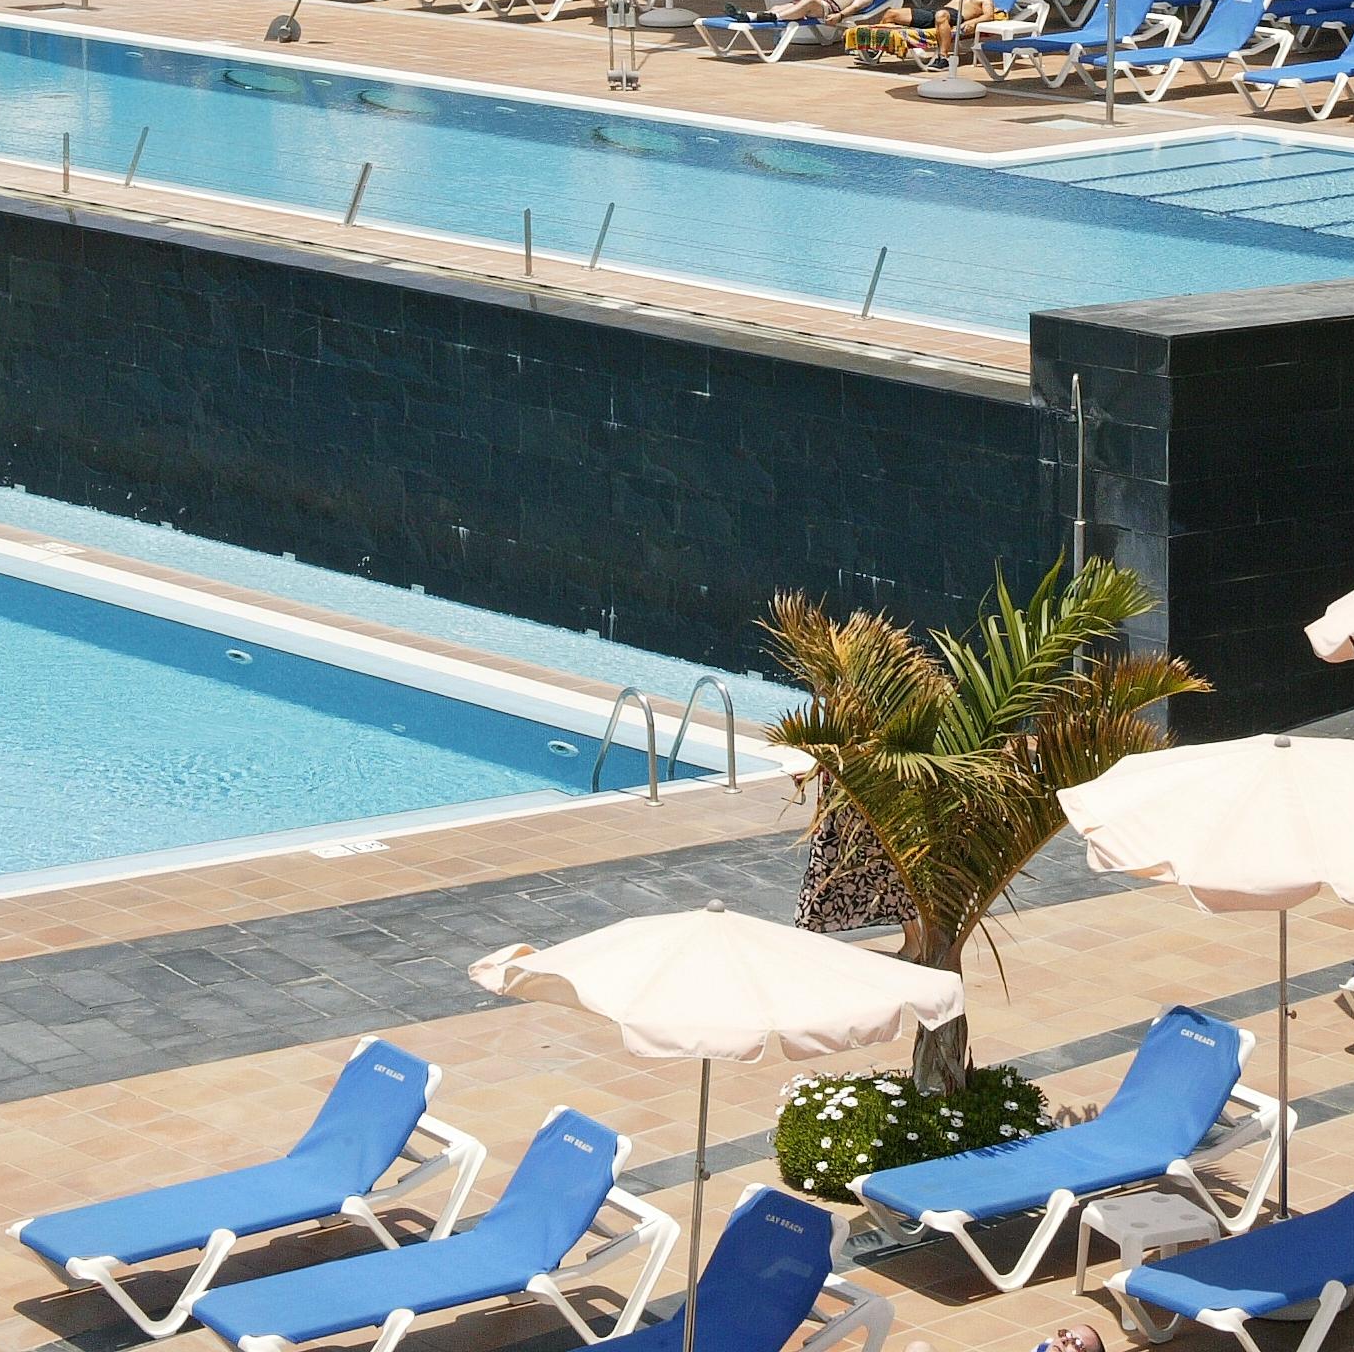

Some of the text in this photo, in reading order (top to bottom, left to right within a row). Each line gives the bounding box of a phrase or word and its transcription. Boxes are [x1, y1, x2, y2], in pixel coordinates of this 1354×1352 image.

[1180, 1028, 1216, 1048] CAY BEACH
[765, 1214, 805, 1234] CAY BEACH
